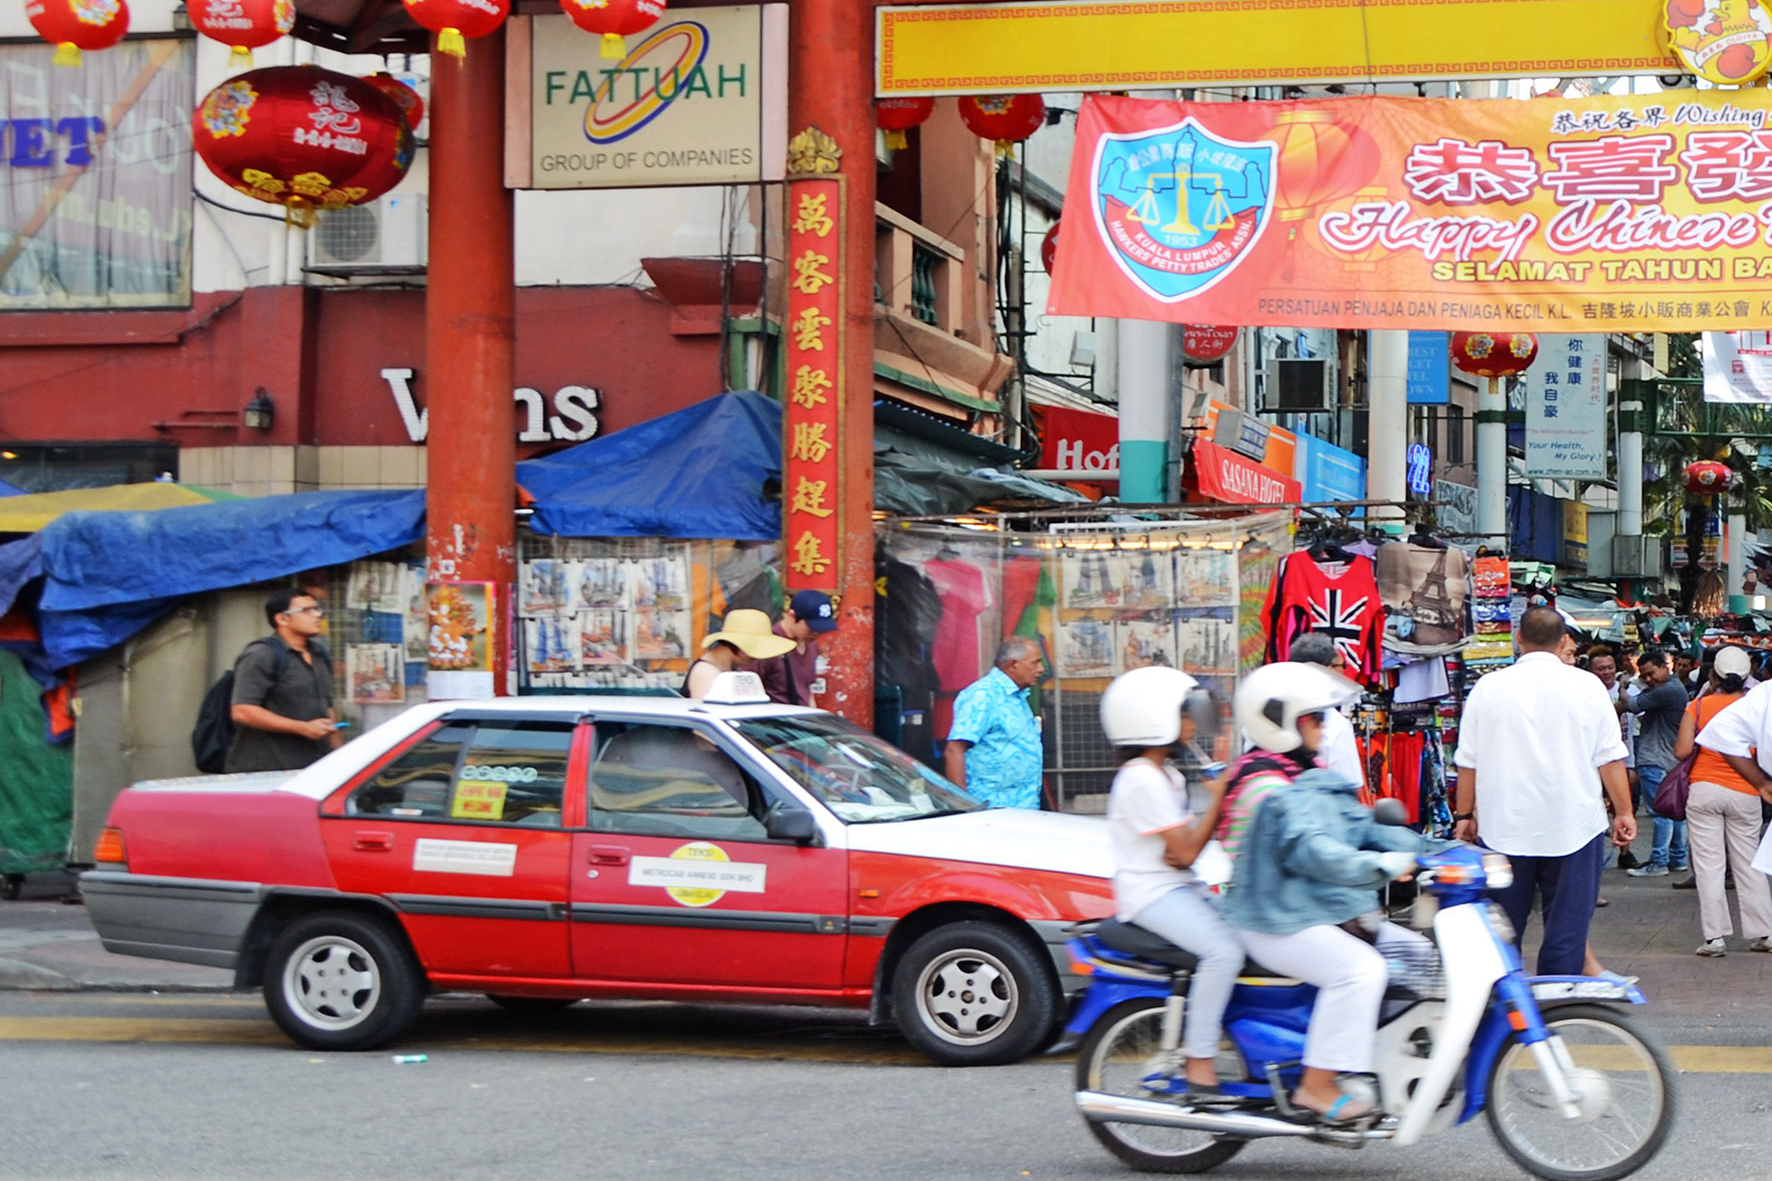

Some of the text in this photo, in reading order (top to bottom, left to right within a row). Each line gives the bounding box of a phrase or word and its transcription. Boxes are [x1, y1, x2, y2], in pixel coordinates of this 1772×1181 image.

[545, 62, 747, 106] FATTUAH
[1553, 107, 1666, 133] 恭祝各界
[1673, 102, 1763, 127] Wishing
[0, 115, 106, 168] ET
[541, 147, 753, 173] GROUP OF COMPANIES
[1134, 231, 1227, 262] KUALA LUMPUR
[1164, 234, 1198, 247] 1953
[1318, 200, 1540, 270] Happy
[1545, 198, 1758, 253] Chinese
[1151, 256, 1188, 272] PETTY
[1432, 259, 1595, 283] SELAMAT
[1601, 258, 1723, 283] TAHUN
[1257, 298, 1572, 320] PERSATUAN PENJAJA DAN PENIAGA KECIL K.L.
[1567, 338, 1584, 386] 你健康
[380, 367, 600, 443] Vns
[1543, 371, 1559, 419] 我自豪
[1528, 441, 1548, 450] Your
[1554, 452, 1567, 461] My
